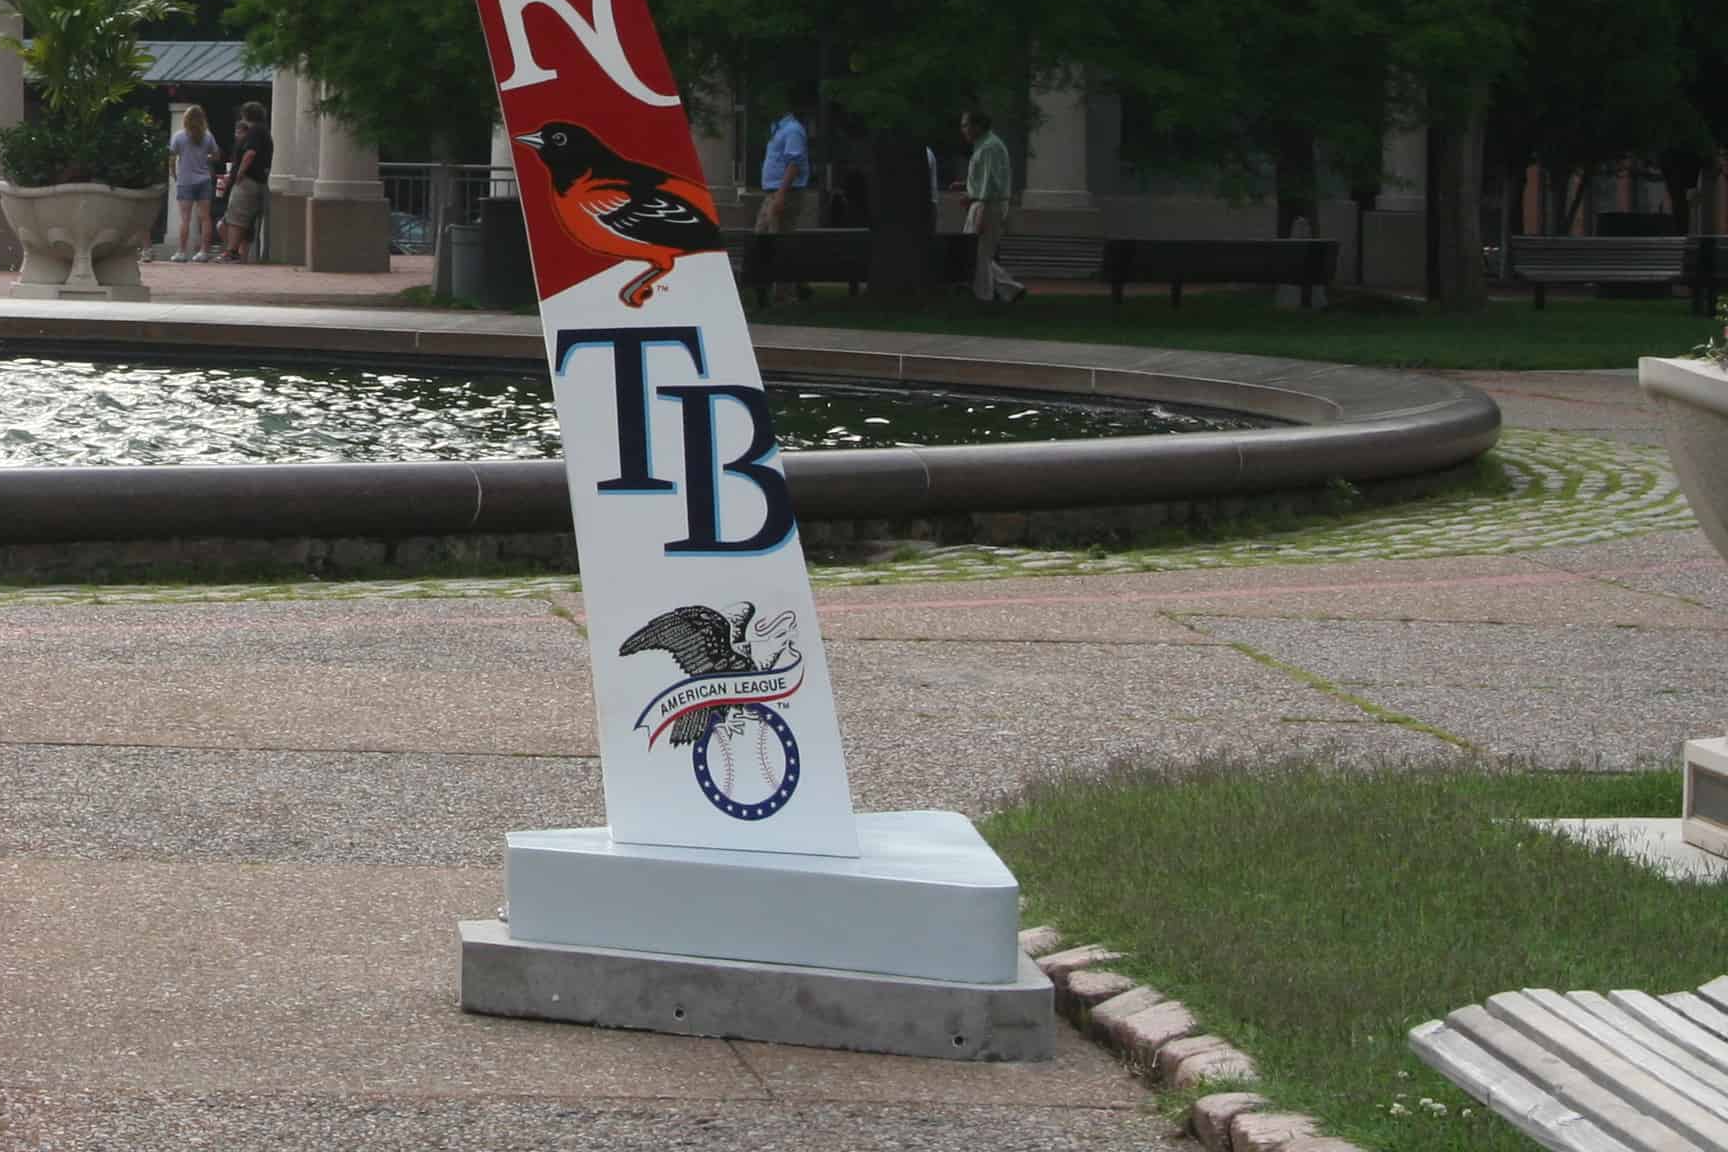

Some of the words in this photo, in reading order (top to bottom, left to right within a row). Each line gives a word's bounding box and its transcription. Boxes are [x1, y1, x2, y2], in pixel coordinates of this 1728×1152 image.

[555, 326, 797, 557] TB
[659, 684, 727, 716] AMERICAN
[734, 677, 787, 694] LEAGUE
